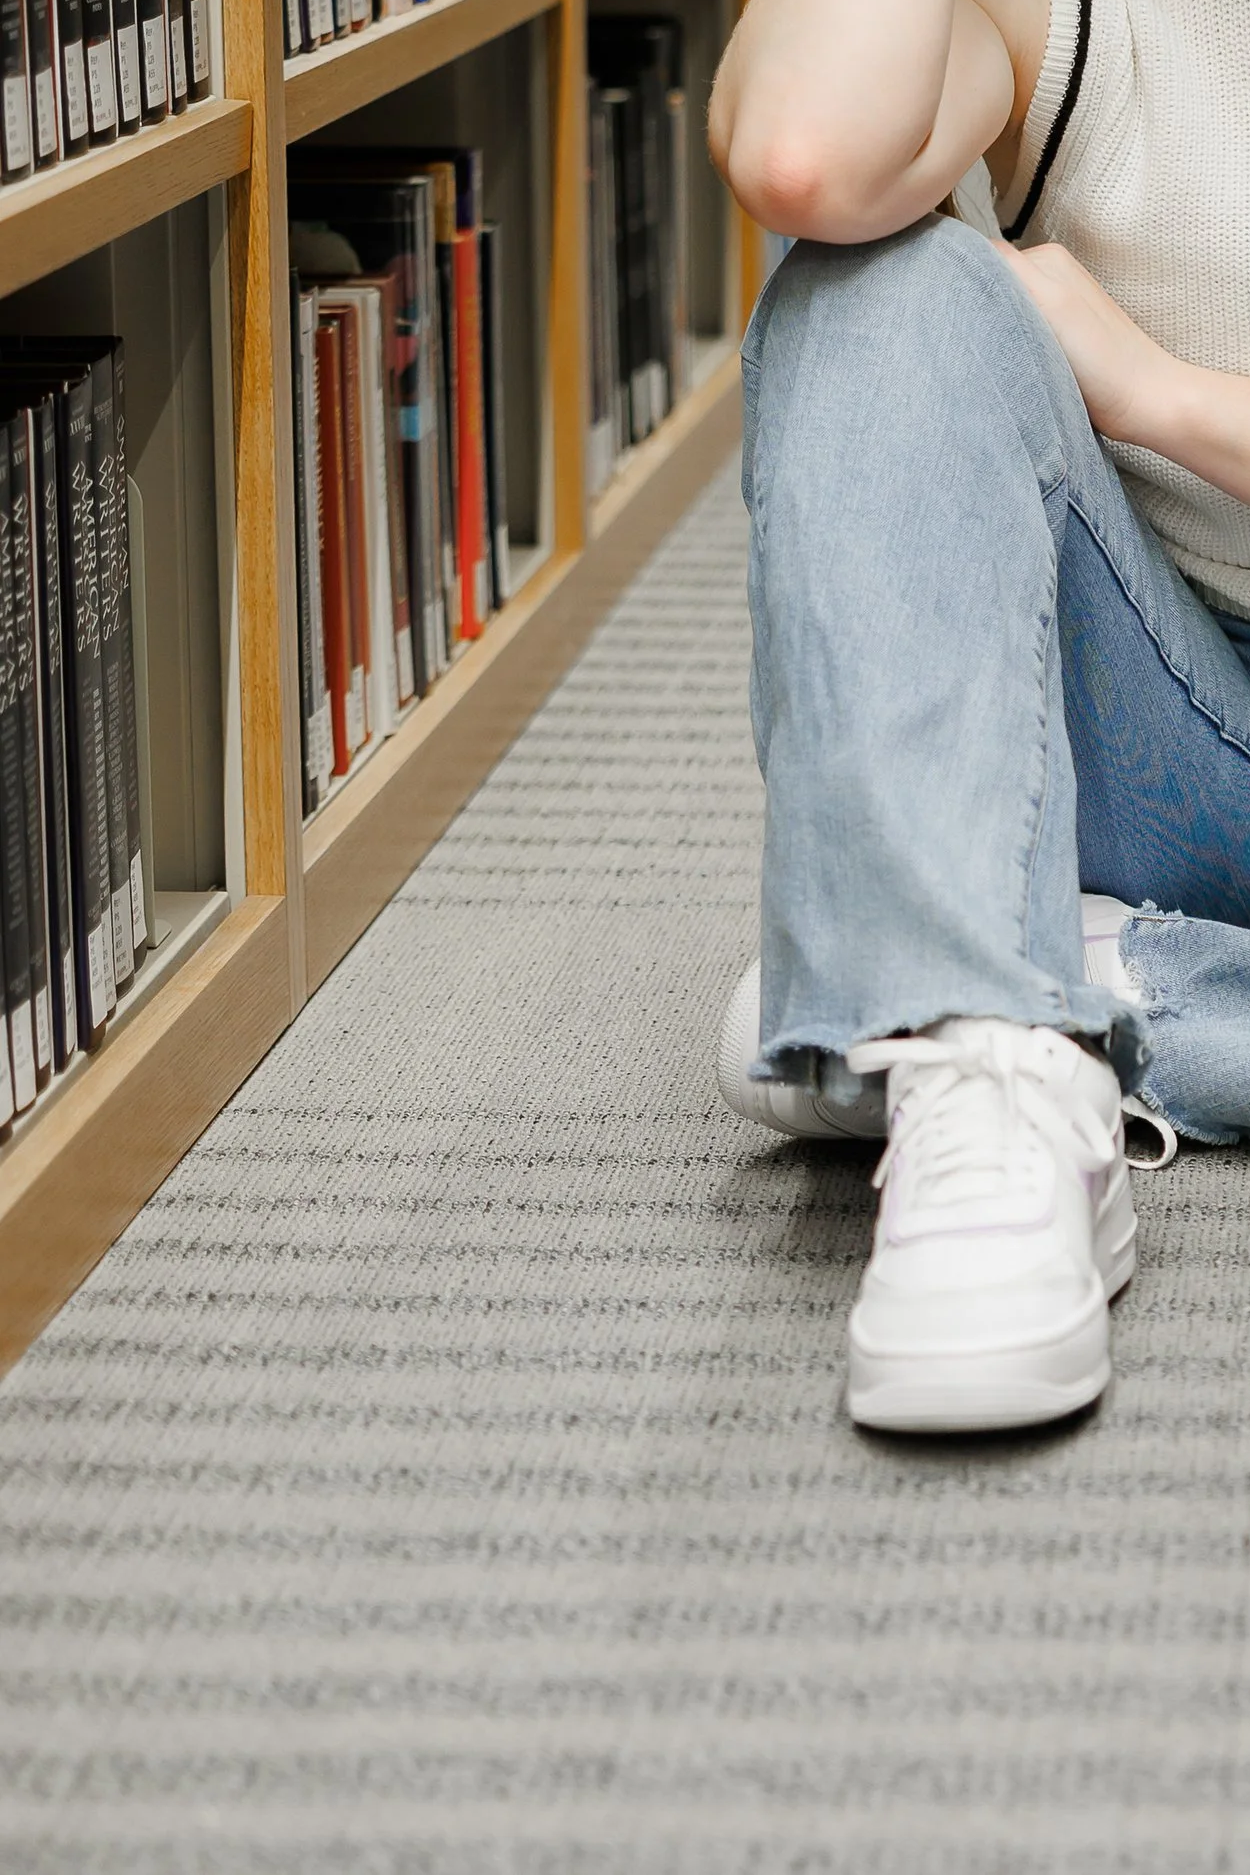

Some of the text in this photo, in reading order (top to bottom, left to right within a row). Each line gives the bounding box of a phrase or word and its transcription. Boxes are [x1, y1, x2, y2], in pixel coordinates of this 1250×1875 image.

[13, 495, 28, 691] WRITERS
[72, 462, 86, 652] WRITERS
[85, 477, 100, 659] AMERICAN
[98, 457, 112, 642] WRITERS
[107, 454, 120, 632] AMERICAN
